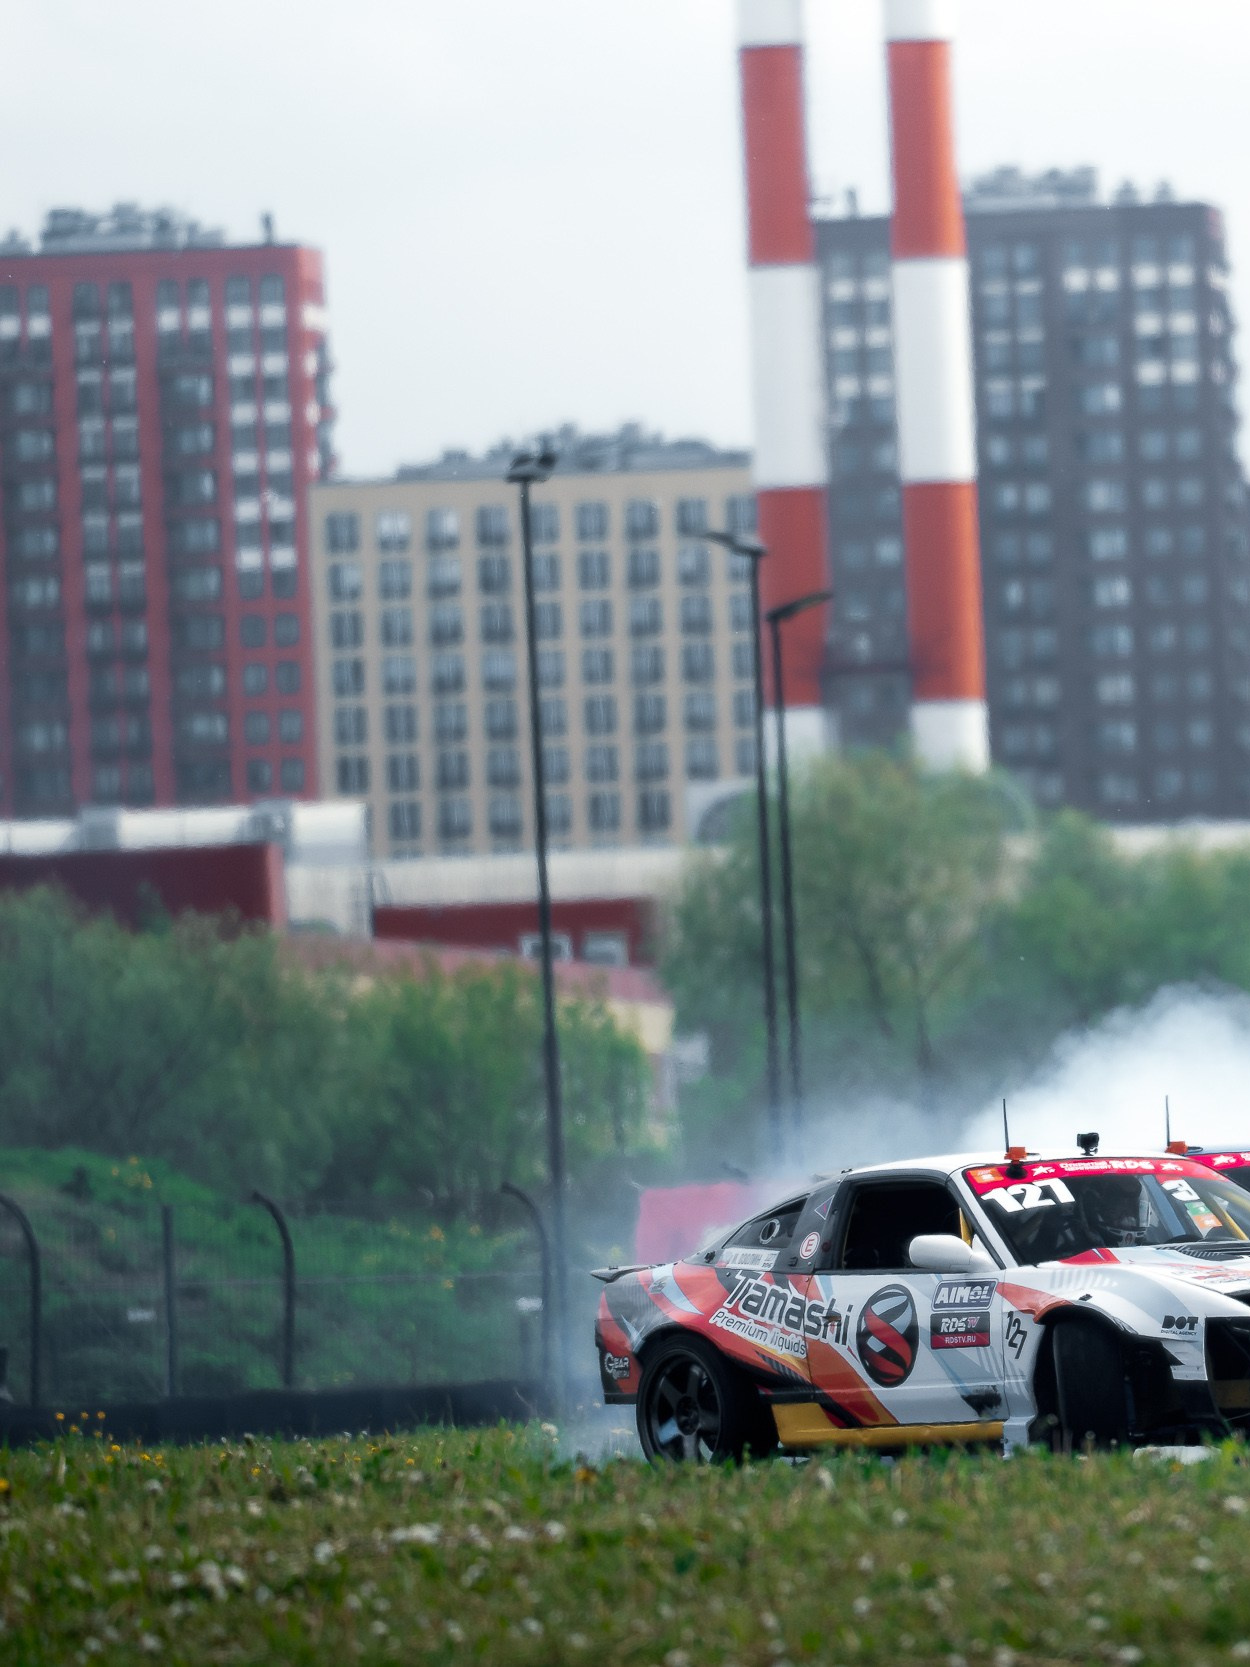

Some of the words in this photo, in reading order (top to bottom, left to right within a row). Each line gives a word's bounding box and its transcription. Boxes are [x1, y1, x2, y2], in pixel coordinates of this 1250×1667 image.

[980, 1178, 1076, 1213] 127
[725, 1270, 854, 1346] Tamashi
[935, 1285, 991, 1304] AIMOL
[712, 1311, 768, 1342] Premium
[770, 1332, 806, 1356] liquids
[940, 1317, 967, 1333] RDS
[1005, 1311, 1028, 1359] 127
[1162, 1315, 1199, 1330] DOT
[944, 1335, 976, 1344] RDSTV.RU
